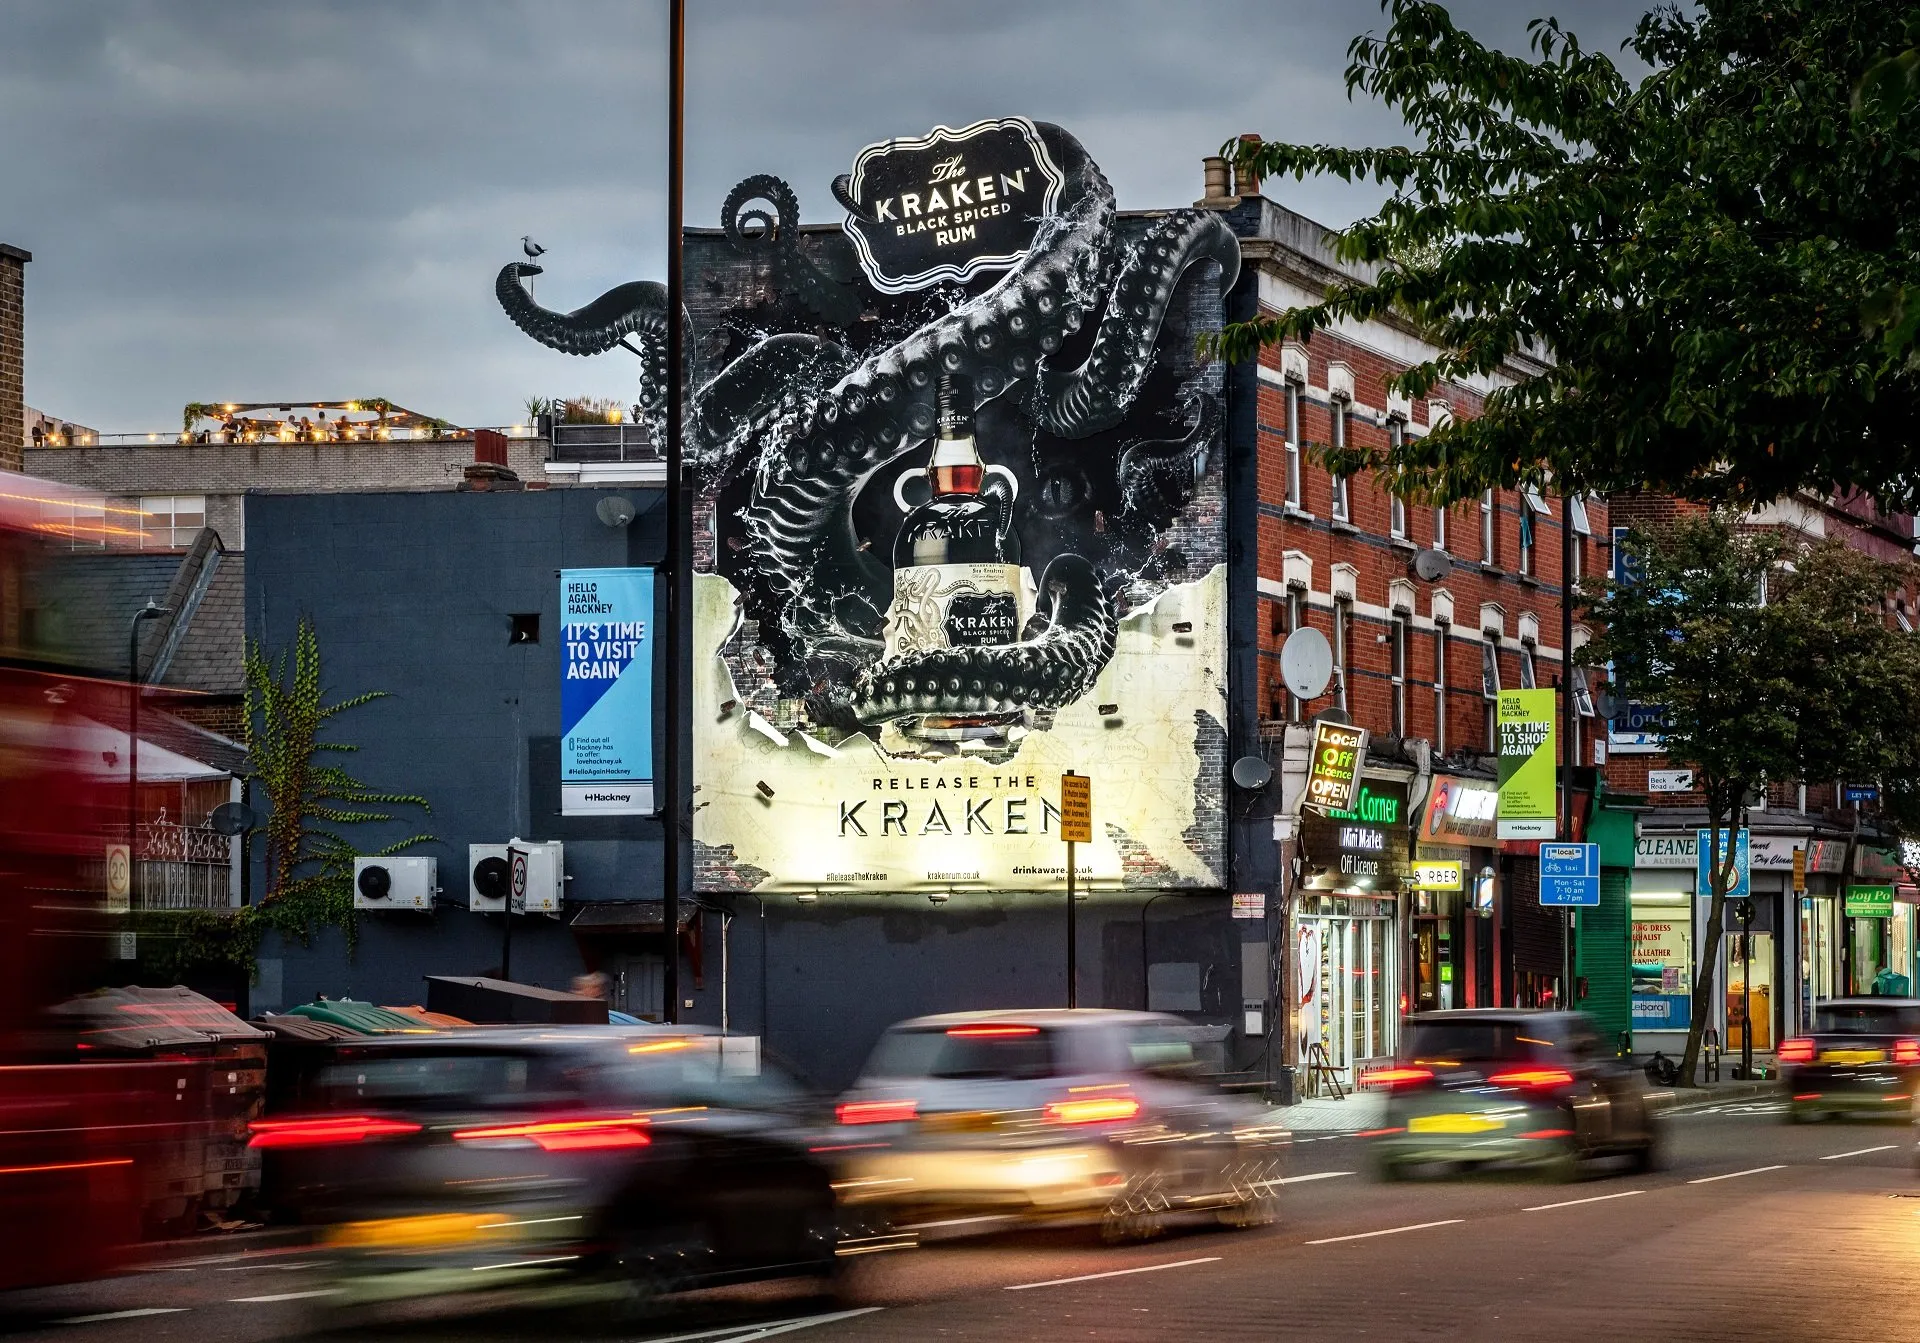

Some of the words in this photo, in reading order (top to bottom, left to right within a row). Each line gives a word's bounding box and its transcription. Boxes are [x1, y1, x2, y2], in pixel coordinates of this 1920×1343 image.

[928, 153, 966, 185] The
[876, 169, 1025, 223] KRAKEN
[896, 215, 948, 236] BLACK
[954, 203, 1011, 223] SPICED
[936, 225, 976, 246] RUM
[937, 416, 967, 424] KRAKEN
[907, 519, 990, 543] KRAKE
[568, 583, 598, 593] HELLO
[568, 593, 600, 604] AGAIN,
[568, 604, 613, 614] HACKNEY
[955, 616, 1014, 629] KRAKEN
[567, 622, 600, 640] IT'S
[604, 622, 646, 640] TIME
[567, 642, 589, 660] TO
[593, 641, 638, 660] VISIT
[567, 661, 620, 680] AGAIN
[1501, 722, 1521, 733] IT'S
[1524, 721, 1550, 732] TIME
[1319, 728, 1361, 747] Local
[1501, 734, 1515, 744] TO
[1518, 733, 1547, 744] SHOP
[1322, 748, 1353, 768] Off
[1501, 745, 1534, 756] AGAIN
[1315, 764, 1352, 780] Licence
[873, 776, 979, 790] RELEASE
[993, 775, 1035, 788] THE
[1311, 779, 1350, 799] OPEN
[594, 793, 630, 802] Hackney
[1361, 787, 1398, 823] Corner
[837, 796, 1062, 837] KRAKEN
[1343, 827, 1358, 847] Mini
[1359, 829, 1383, 849] Market
[1637, 839, 1698, 855] CLEANE
[1340, 854, 1352, 874] Off
[1353, 856, 1378, 875] Licence
[1754, 854, 1770, 865] Dry
[1770, 854, 1793, 864] Cleane
[112, 862, 126, 880] 20
[515, 868, 524, 885] 20
[826, 872, 888, 882] #ReleaseTheKraken
[927, 870, 980, 881] krakenrum.co.uk
[1012, 866, 1093, 874] drinkaware.o.uk
[1414, 870, 1458, 883] BRBER
[1848, 890, 1872, 902] Joy
[1874, 890, 1890, 900] Po
